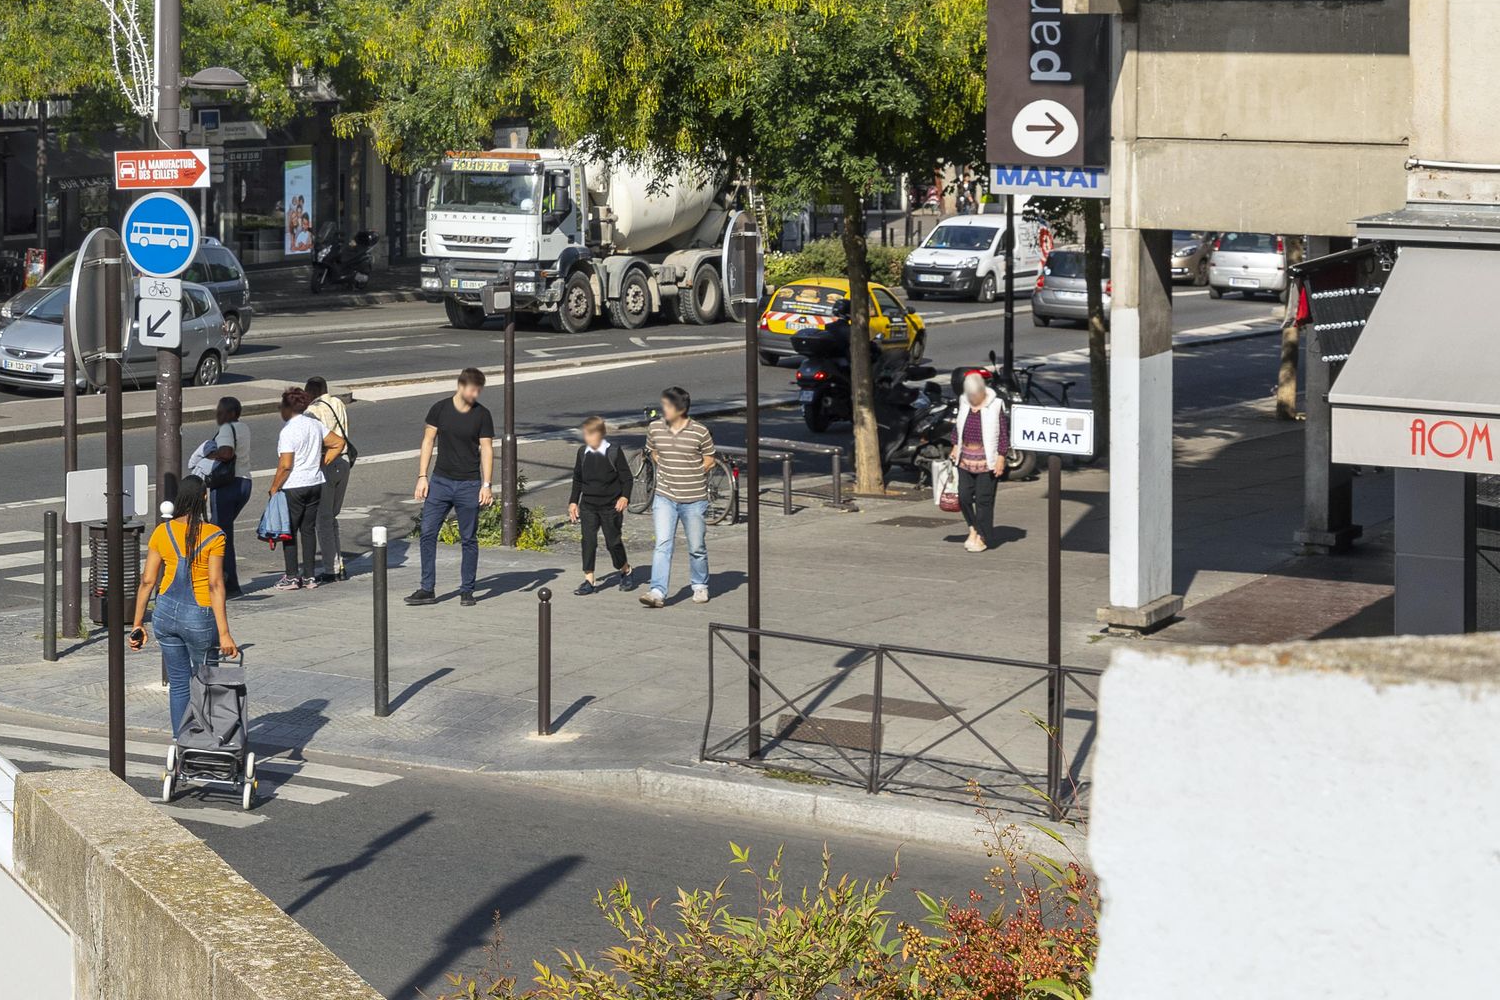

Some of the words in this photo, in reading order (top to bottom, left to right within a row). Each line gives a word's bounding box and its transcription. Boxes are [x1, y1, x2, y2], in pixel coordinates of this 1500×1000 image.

[138, 159, 147, 170] LA
[148, 158, 197, 169] MANUFACTURE
[138, 169, 151, 180] DES
[996, 165, 1105, 189] MARAT
[456, 235, 494, 245] IVECO
[1042, 415, 1062, 427] RUE
[1021, 430, 1082, 446] MARAT
